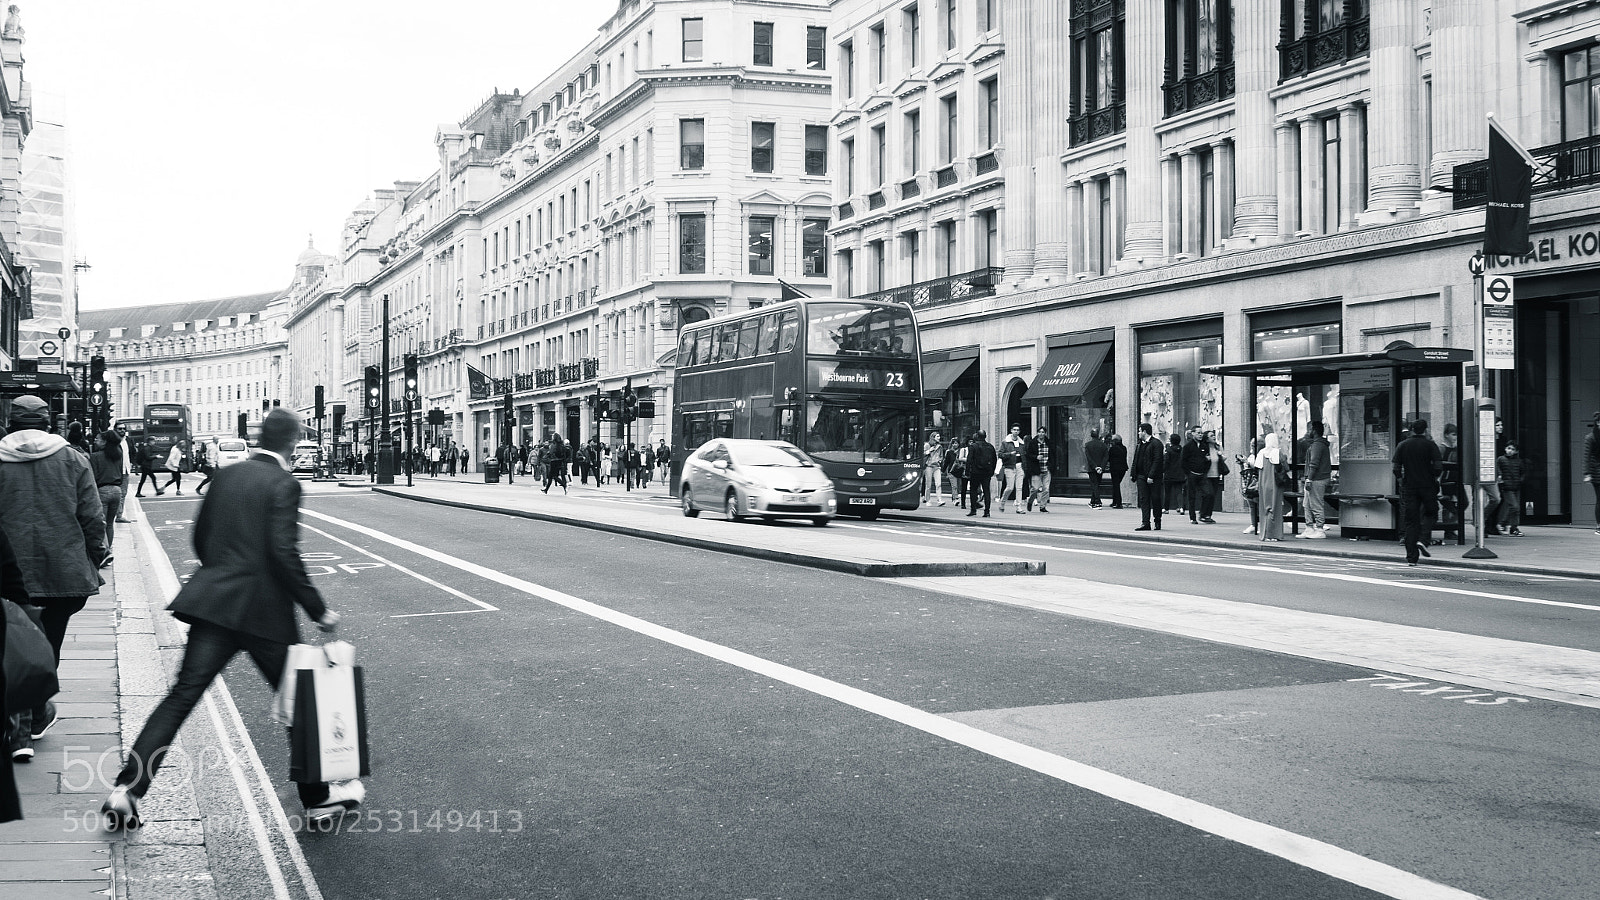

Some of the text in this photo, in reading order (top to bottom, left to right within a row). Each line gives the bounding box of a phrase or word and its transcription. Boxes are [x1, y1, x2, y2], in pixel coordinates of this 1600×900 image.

[1568, 231, 1600, 258] KO
[1471, 256, 1486, 272] M
[822, 371, 869, 383] Westbourne Park
[1053, 362, 1081, 377] POLO
[886, 372, 904, 387] 23
[1042, 376, 1080, 386] RALPH LAUREN
[1346, 673, 1530, 705] TAXIS
